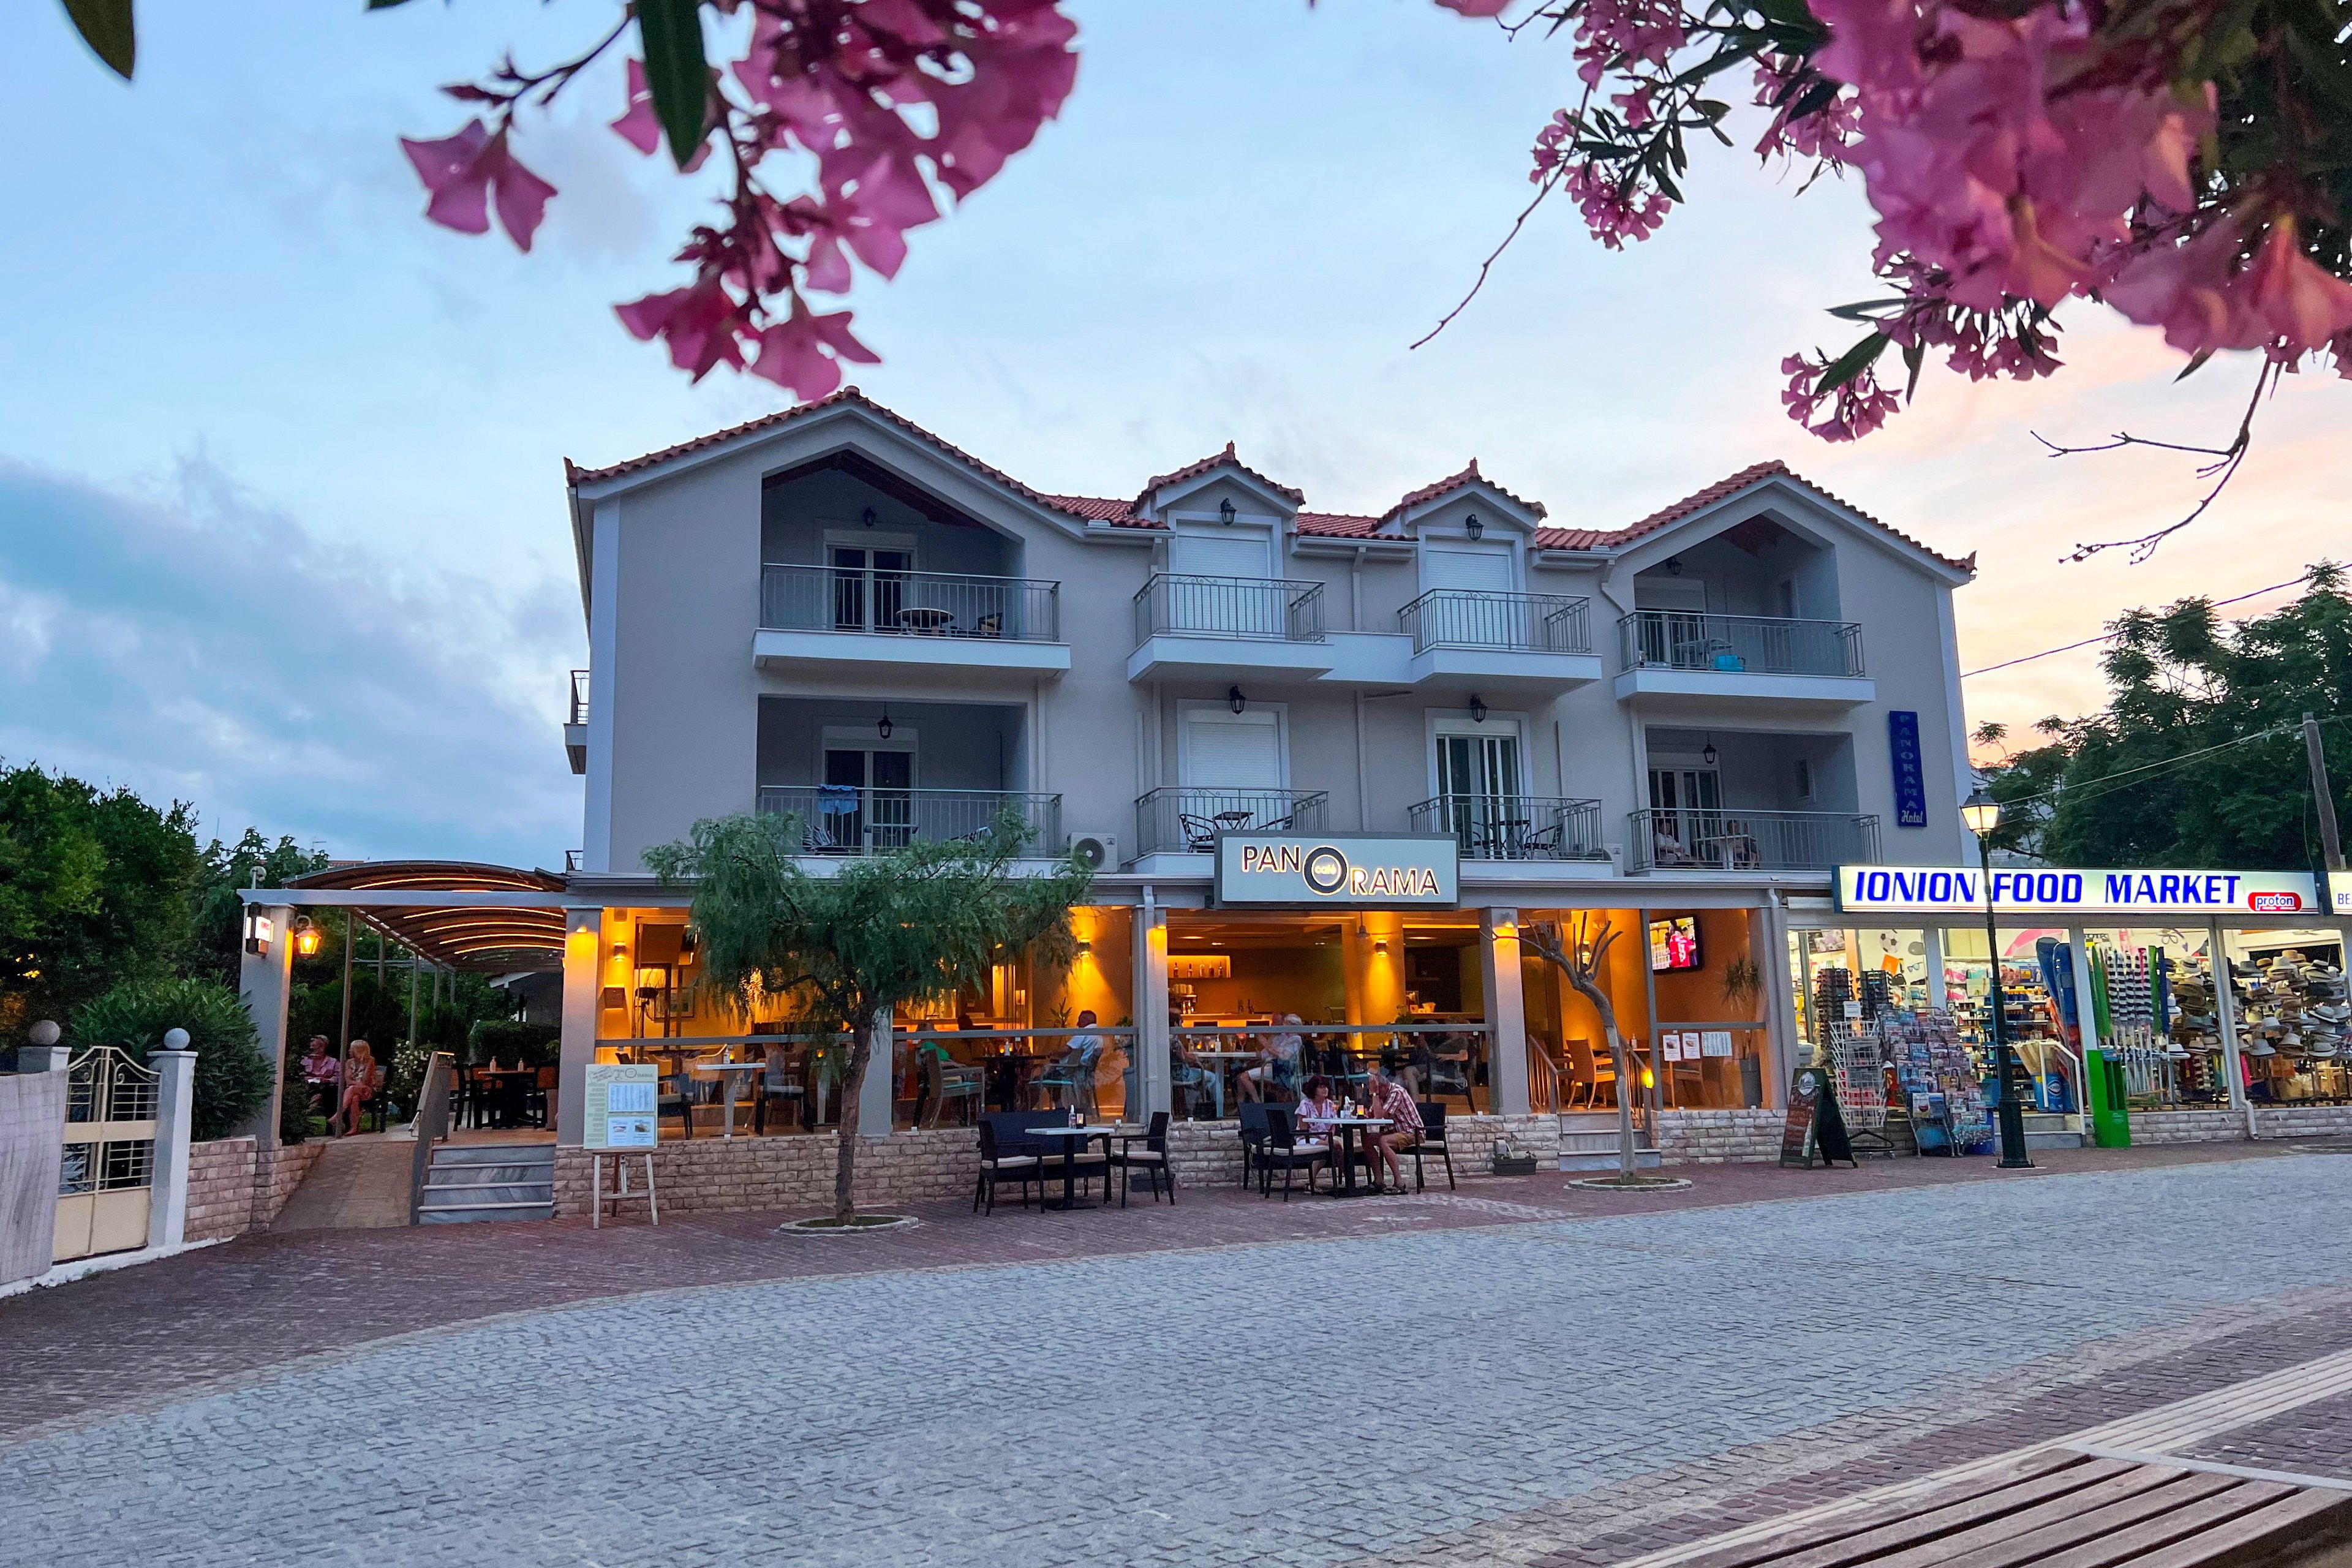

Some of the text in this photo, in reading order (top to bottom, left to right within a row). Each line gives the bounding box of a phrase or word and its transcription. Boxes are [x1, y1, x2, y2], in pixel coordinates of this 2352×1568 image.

[1901, 810, 1923, 823] Hotel
[1855, 872, 2241, 903] IONION FOOD MARKET
[2256, 895, 2293, 909] proton
[2337, 894, 2352, 904] BE
